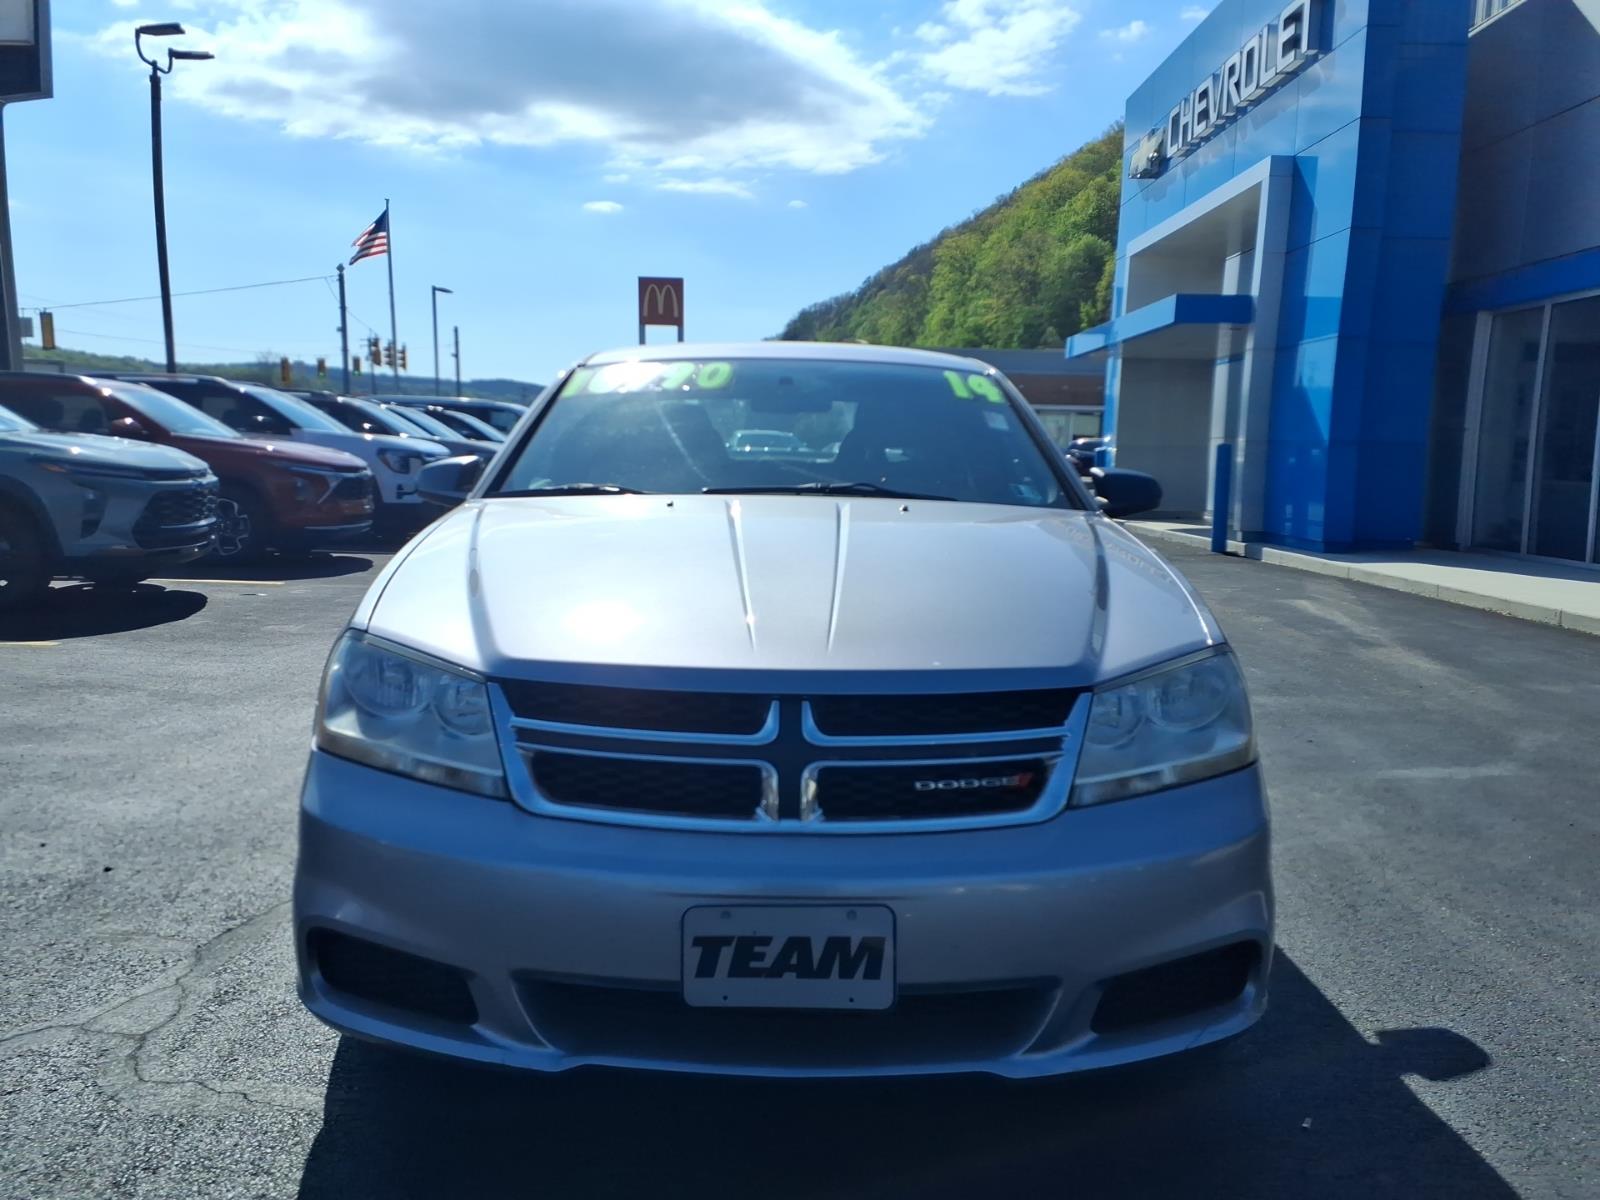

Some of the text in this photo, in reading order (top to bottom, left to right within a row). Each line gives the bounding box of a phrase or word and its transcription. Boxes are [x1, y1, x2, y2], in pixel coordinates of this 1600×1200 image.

[1166, 0, 1311, 158] CHEVROLET
[914, 775, 1020, 791] DODGE
[691, 935, 887, 980] TEAM
